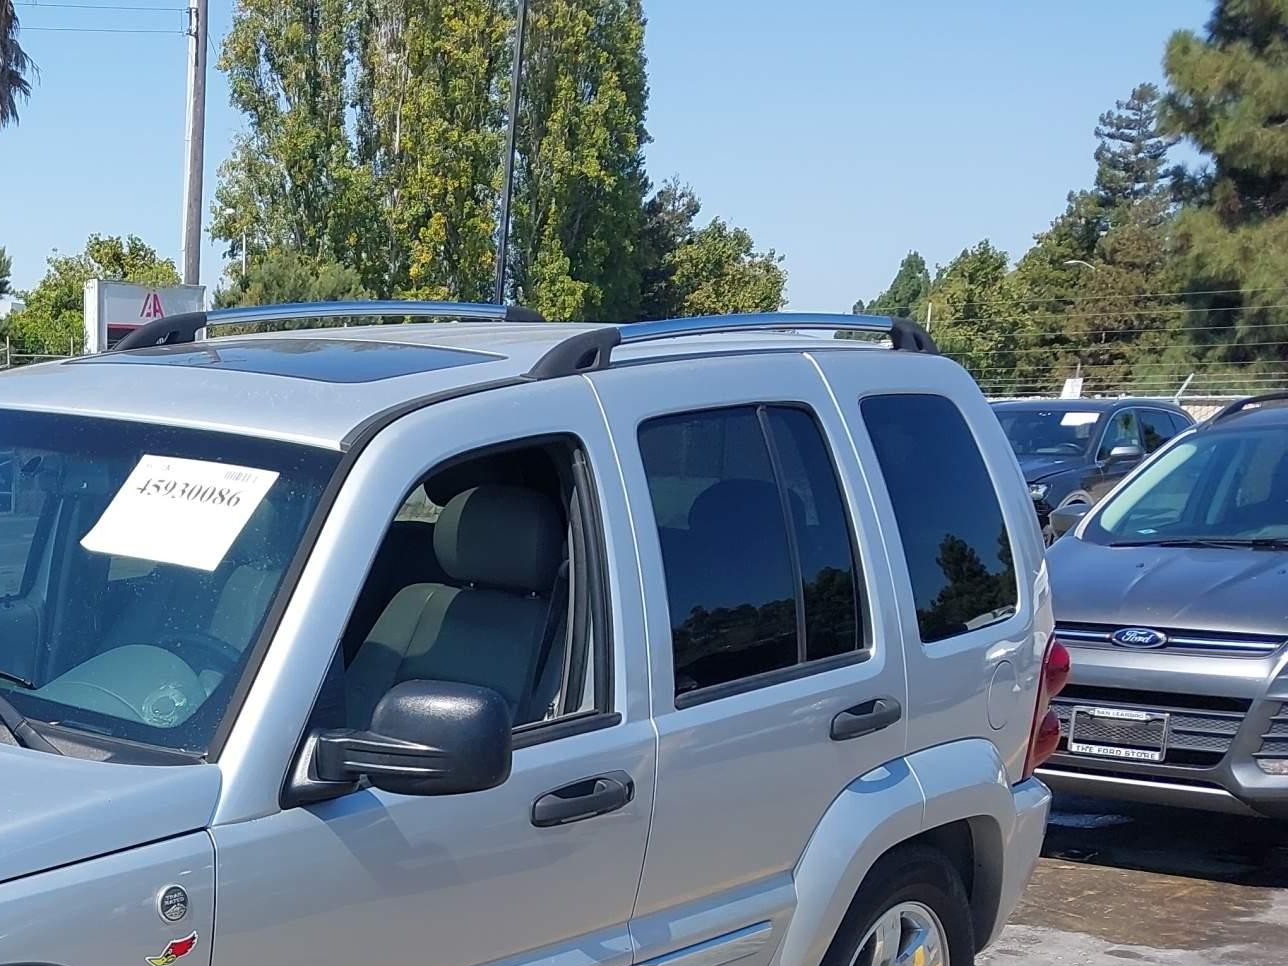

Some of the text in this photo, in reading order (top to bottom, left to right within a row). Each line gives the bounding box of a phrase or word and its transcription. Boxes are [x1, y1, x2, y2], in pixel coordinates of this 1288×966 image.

[136, 478, 243, 507] 45930086
[1121, 630, 1154, 643] Ford
[1076, 745, 1157, 760] THE FORD STORE
